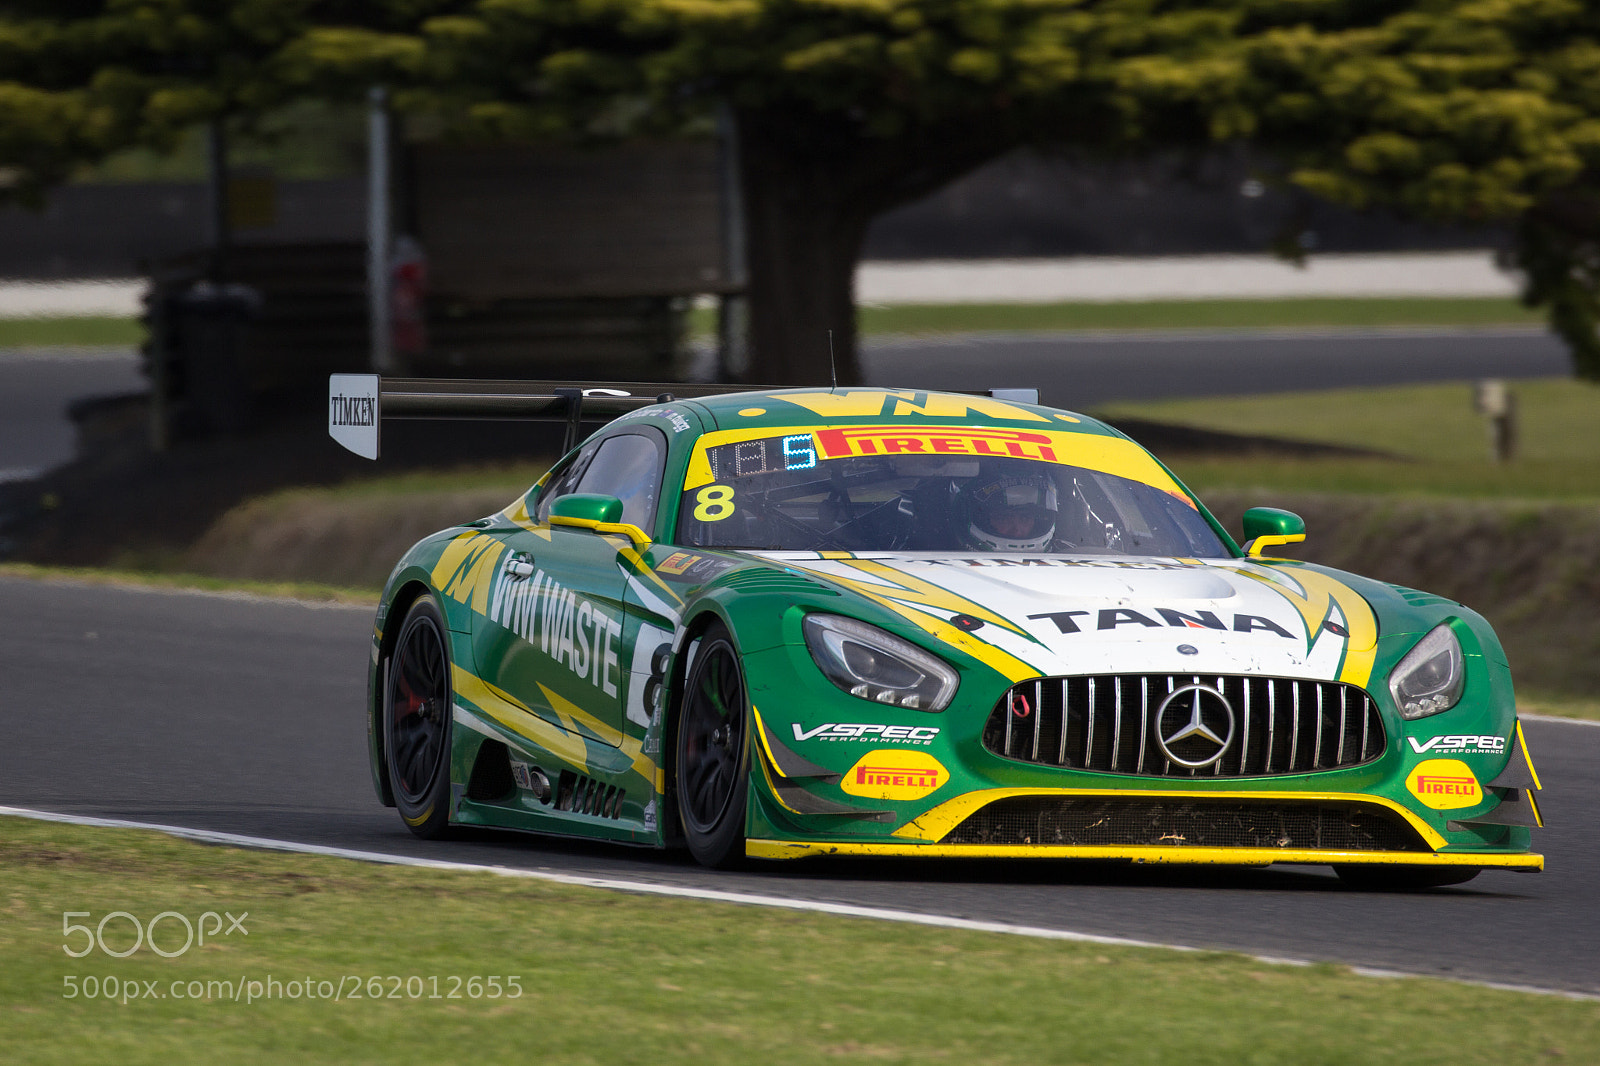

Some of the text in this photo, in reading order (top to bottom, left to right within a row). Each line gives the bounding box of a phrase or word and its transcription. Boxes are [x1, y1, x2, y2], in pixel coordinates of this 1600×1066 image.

[331, 393, 376, 427] TIMKEN
[815, 426, 1058, 462] PIRELLI
[693, 484, 736, 522] 8
[541, 576, 622, 699] WASTE
[1026, 608, 1299, 640] TANA
[819, 736, 933, 746] PERFORMANCE
[856, 766, 939, 788] PIRELLI
[1416, 775, 1475, 796] PIRELLI
